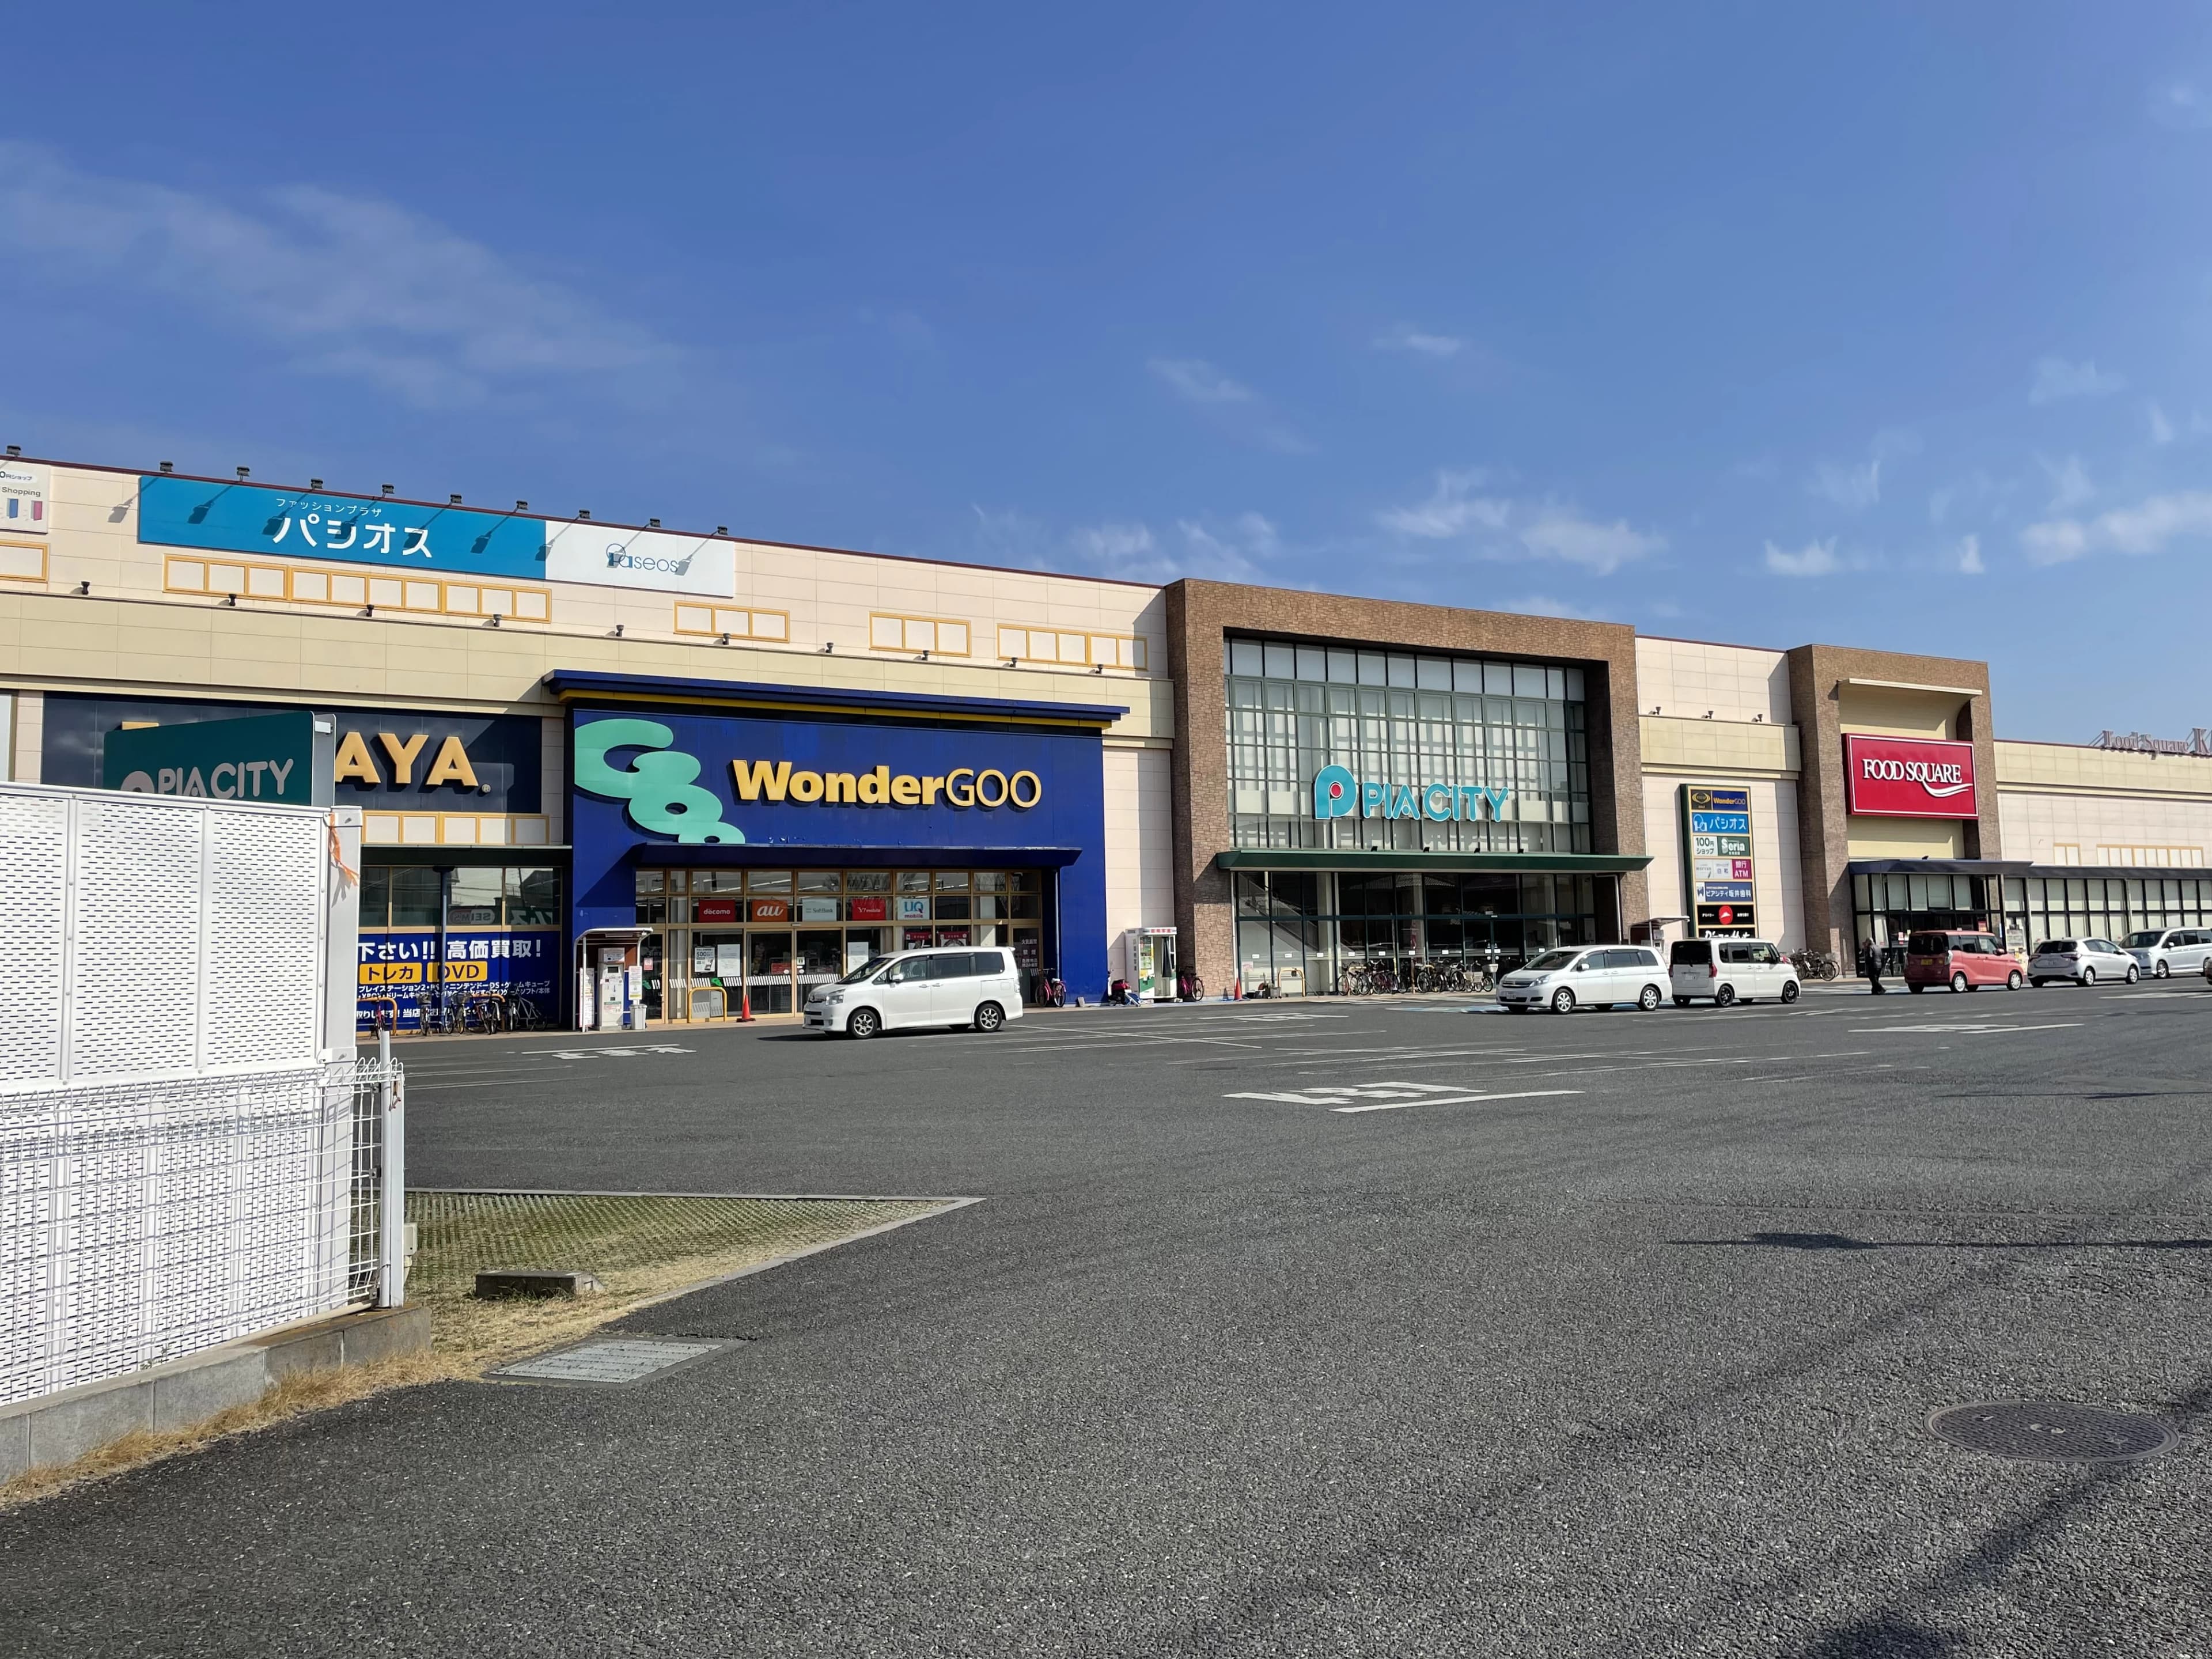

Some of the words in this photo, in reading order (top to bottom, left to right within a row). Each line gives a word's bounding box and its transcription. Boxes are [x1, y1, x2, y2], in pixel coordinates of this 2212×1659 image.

[2, 487, 41, 498] Shopping
[276, 498, 381, 517] ファッションプラザ
[272, 513, 432, 558] パシオス
[1862, 759, 1905, 780] FOOD
[1906, 762, 1967, 789] SQUARE
[732, 759, 1042, 809] WonderGOO
[1709, 816, 1746, 830] パシオス
[757, 906, 783, 916] au
[904, 902, 923, 913] UQ
[368, 965, 414, 981] トレカ
